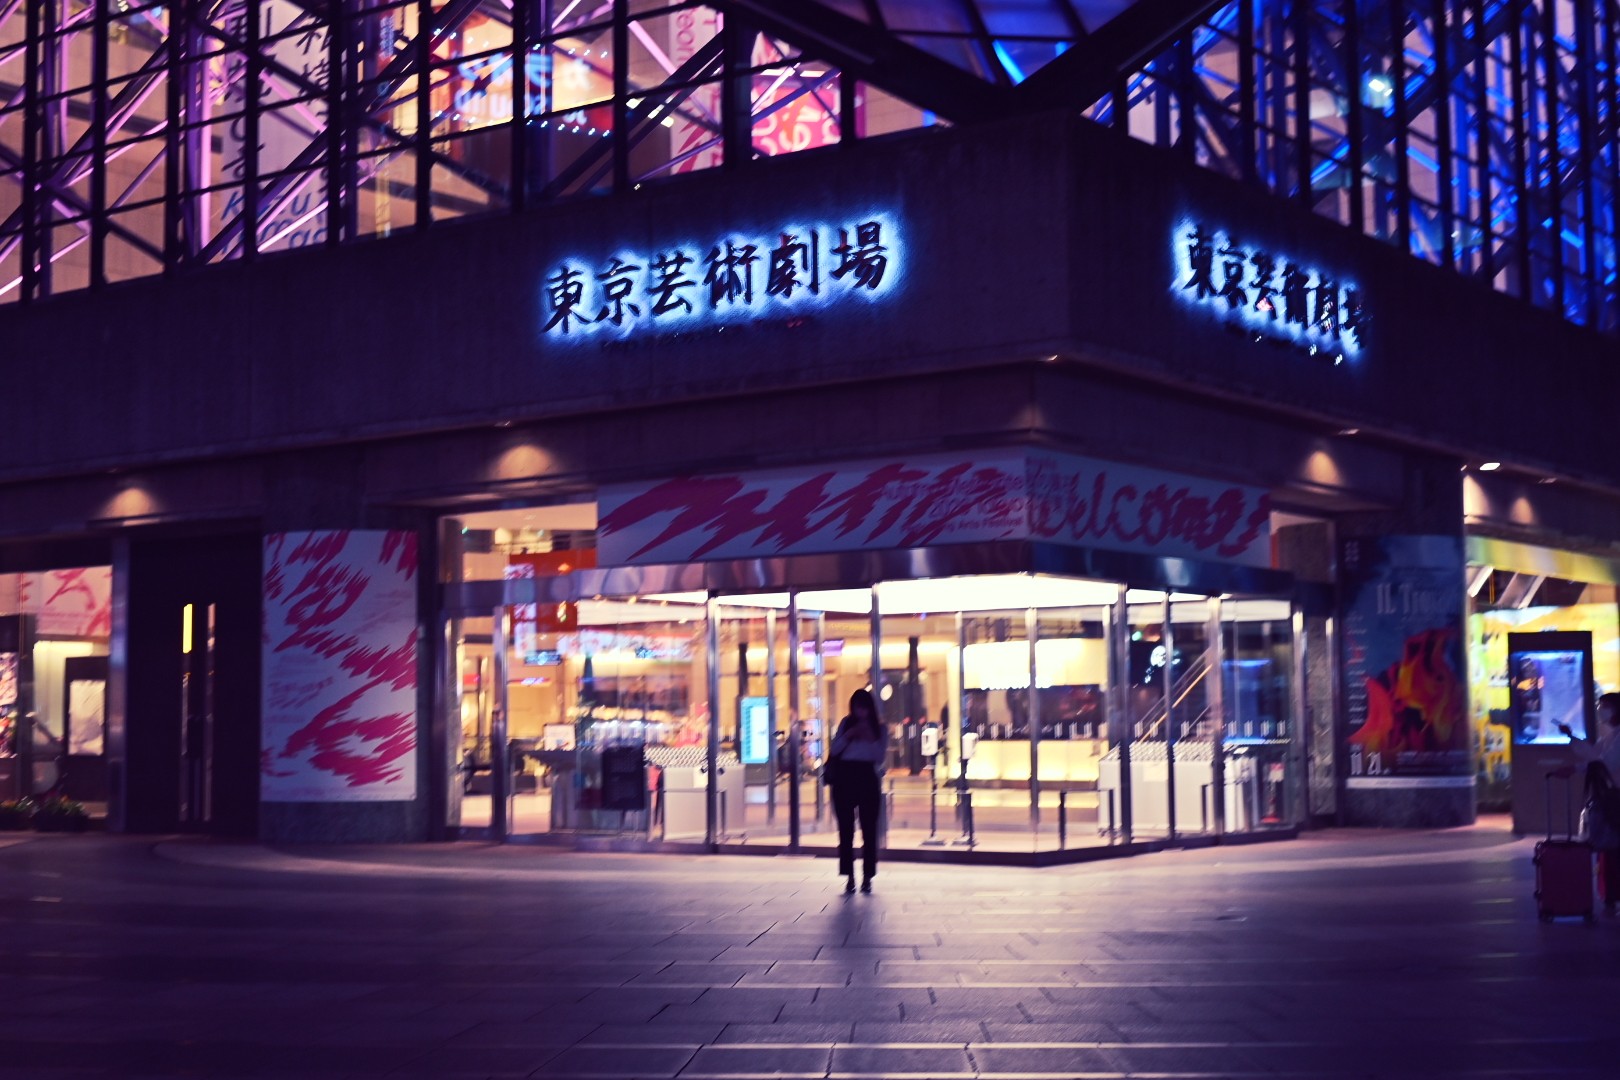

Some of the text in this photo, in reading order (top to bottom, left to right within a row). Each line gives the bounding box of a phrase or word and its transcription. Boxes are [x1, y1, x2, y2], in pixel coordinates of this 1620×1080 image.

[541, 221, 888, 334] 東京芸術劇場
